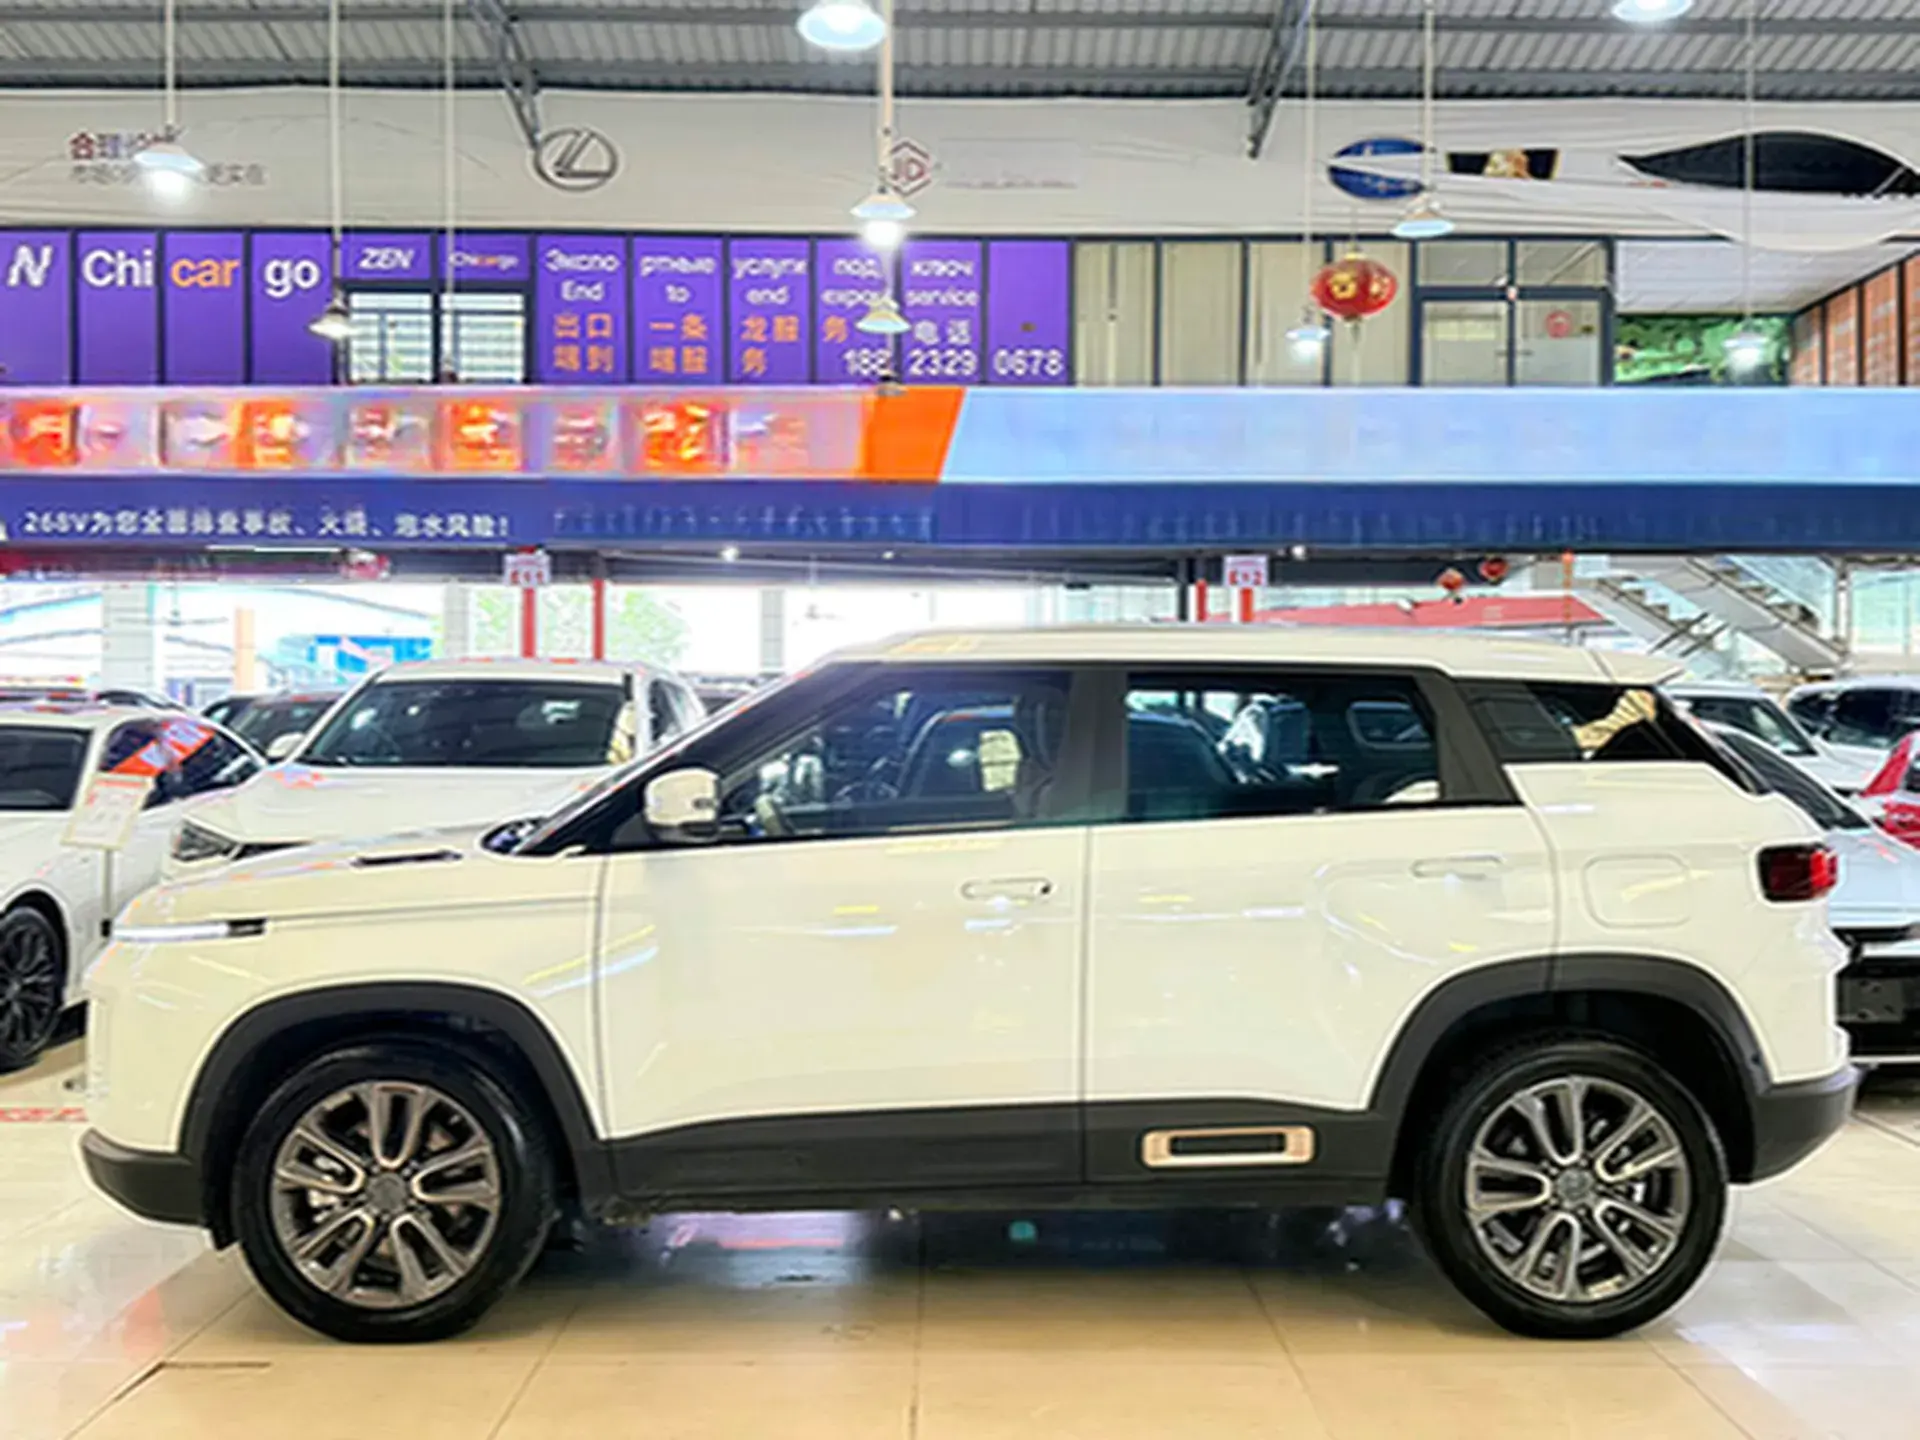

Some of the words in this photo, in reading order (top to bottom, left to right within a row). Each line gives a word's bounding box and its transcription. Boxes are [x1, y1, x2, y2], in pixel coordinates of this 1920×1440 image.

[82, 249, 154, 289] Chi
[171, 256, 239, 289] car
[264, 255, 320, 299] go
[561, 279, 604, 301] End
[666, 284, 690, 303] to
[746, 285, 790, 305] end
[821, 288, 886, 308] expo
[905, 288, 979, 307] service
[993, 348, 1064, 376] 0678
